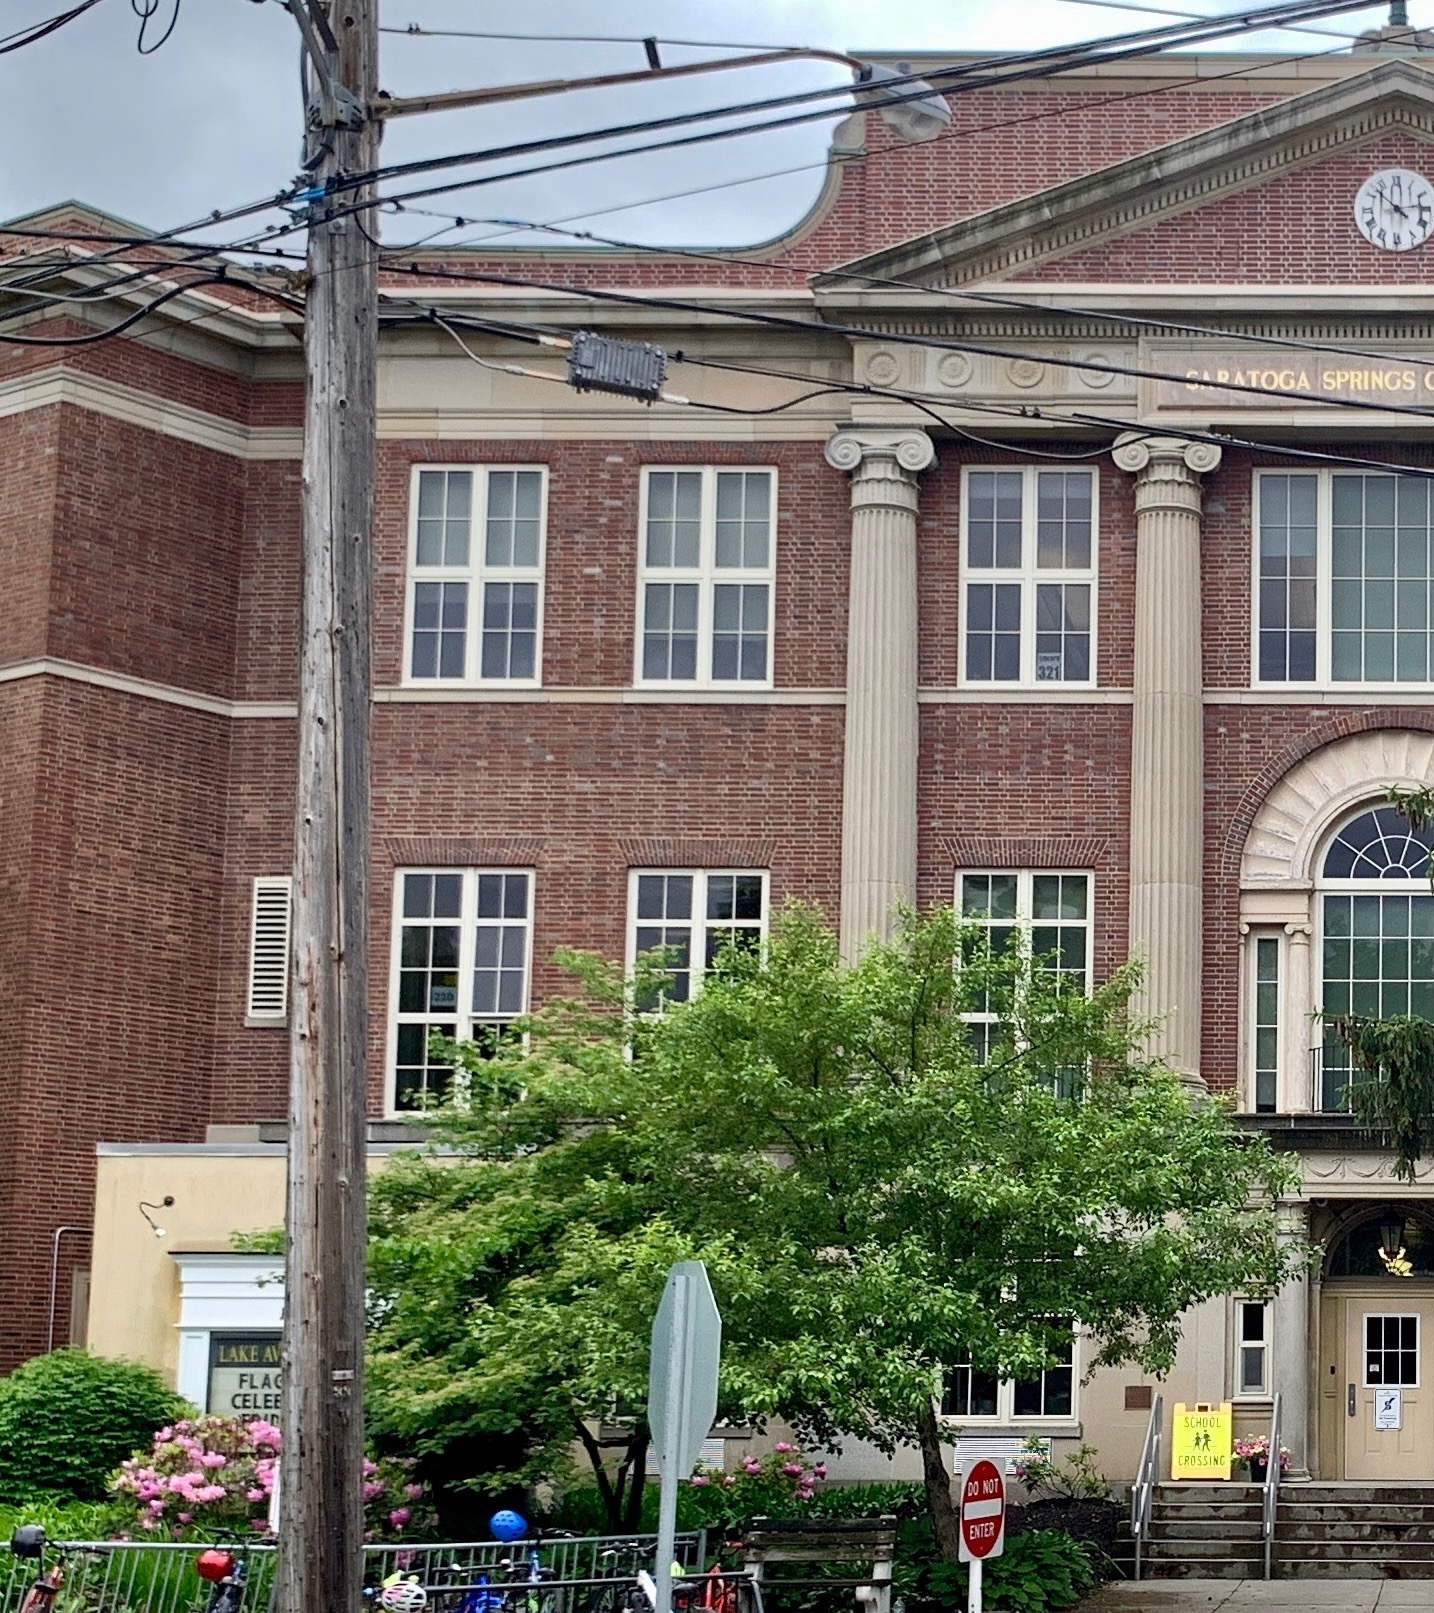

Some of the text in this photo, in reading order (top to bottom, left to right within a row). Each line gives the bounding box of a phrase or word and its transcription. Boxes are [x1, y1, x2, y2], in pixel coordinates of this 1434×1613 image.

[1185, 370, 1311, 391] SARATOGA
[1322, 370, 1416, 391] SPRINGS
[1038, 665, 1060, 680] 321
[219, 1345, 259, 1362] LAKE
[1184, 1416, 1221, 1428] SCHOOL
[1178, 1455, 1226, 1467] CROSSING
[968, 1478, 1000, 1497] DO NOT
[969, 1522, 995, 1540] ENTER
